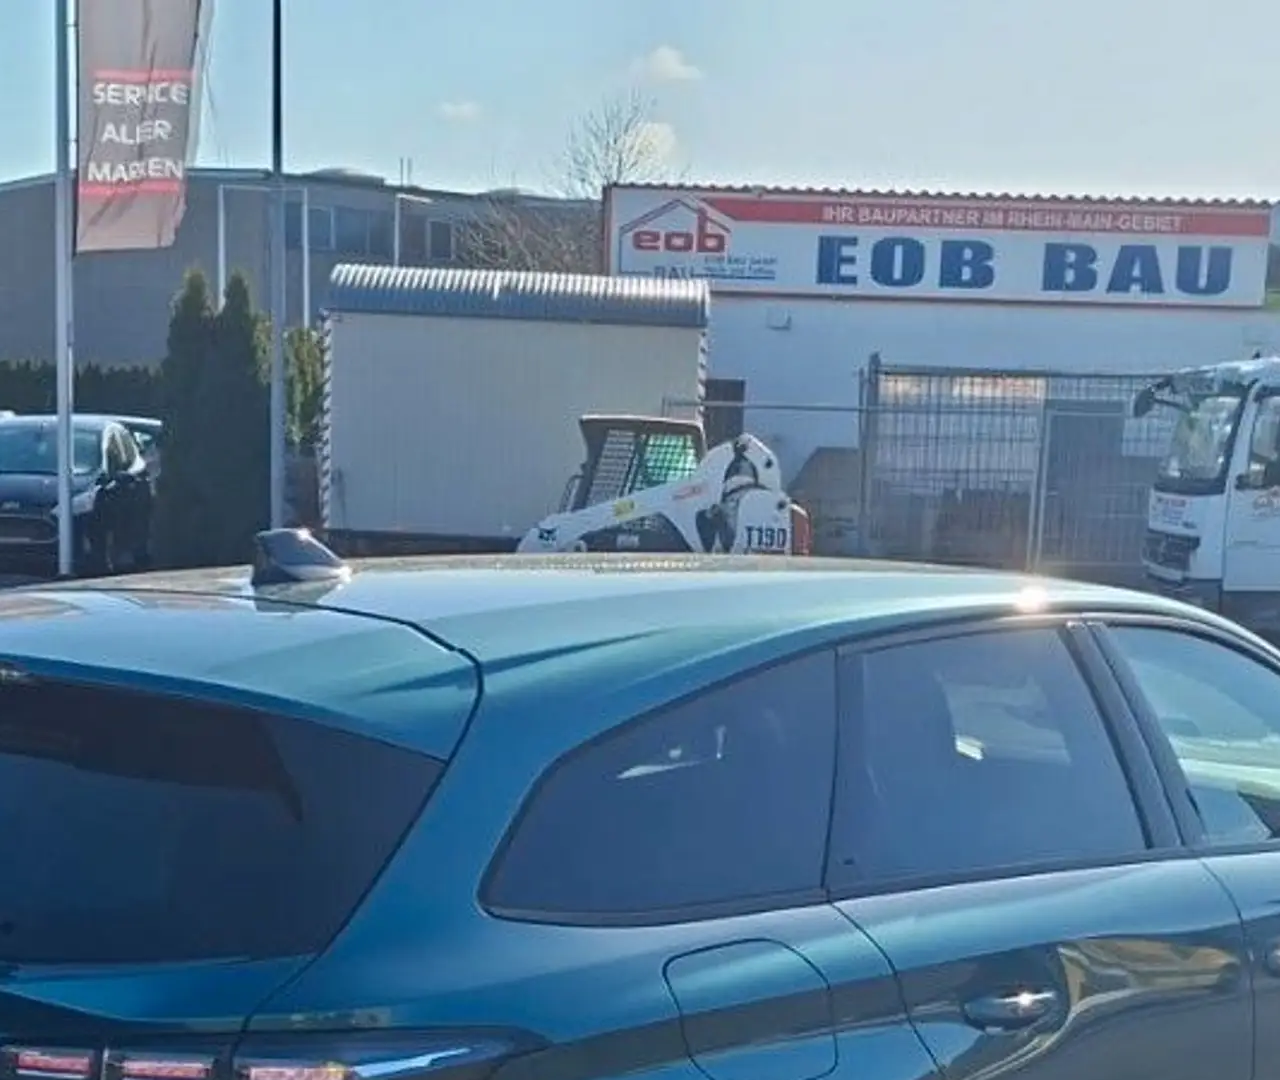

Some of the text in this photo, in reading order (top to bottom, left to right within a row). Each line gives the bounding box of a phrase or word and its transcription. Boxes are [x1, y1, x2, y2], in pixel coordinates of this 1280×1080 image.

[632, 205, 725, 253] eob
[822, 206, 854, 222] IHR
[859, 206, 979, 227] BAUPARTNER
[816, 235, 1233, 295] EOB BAU
